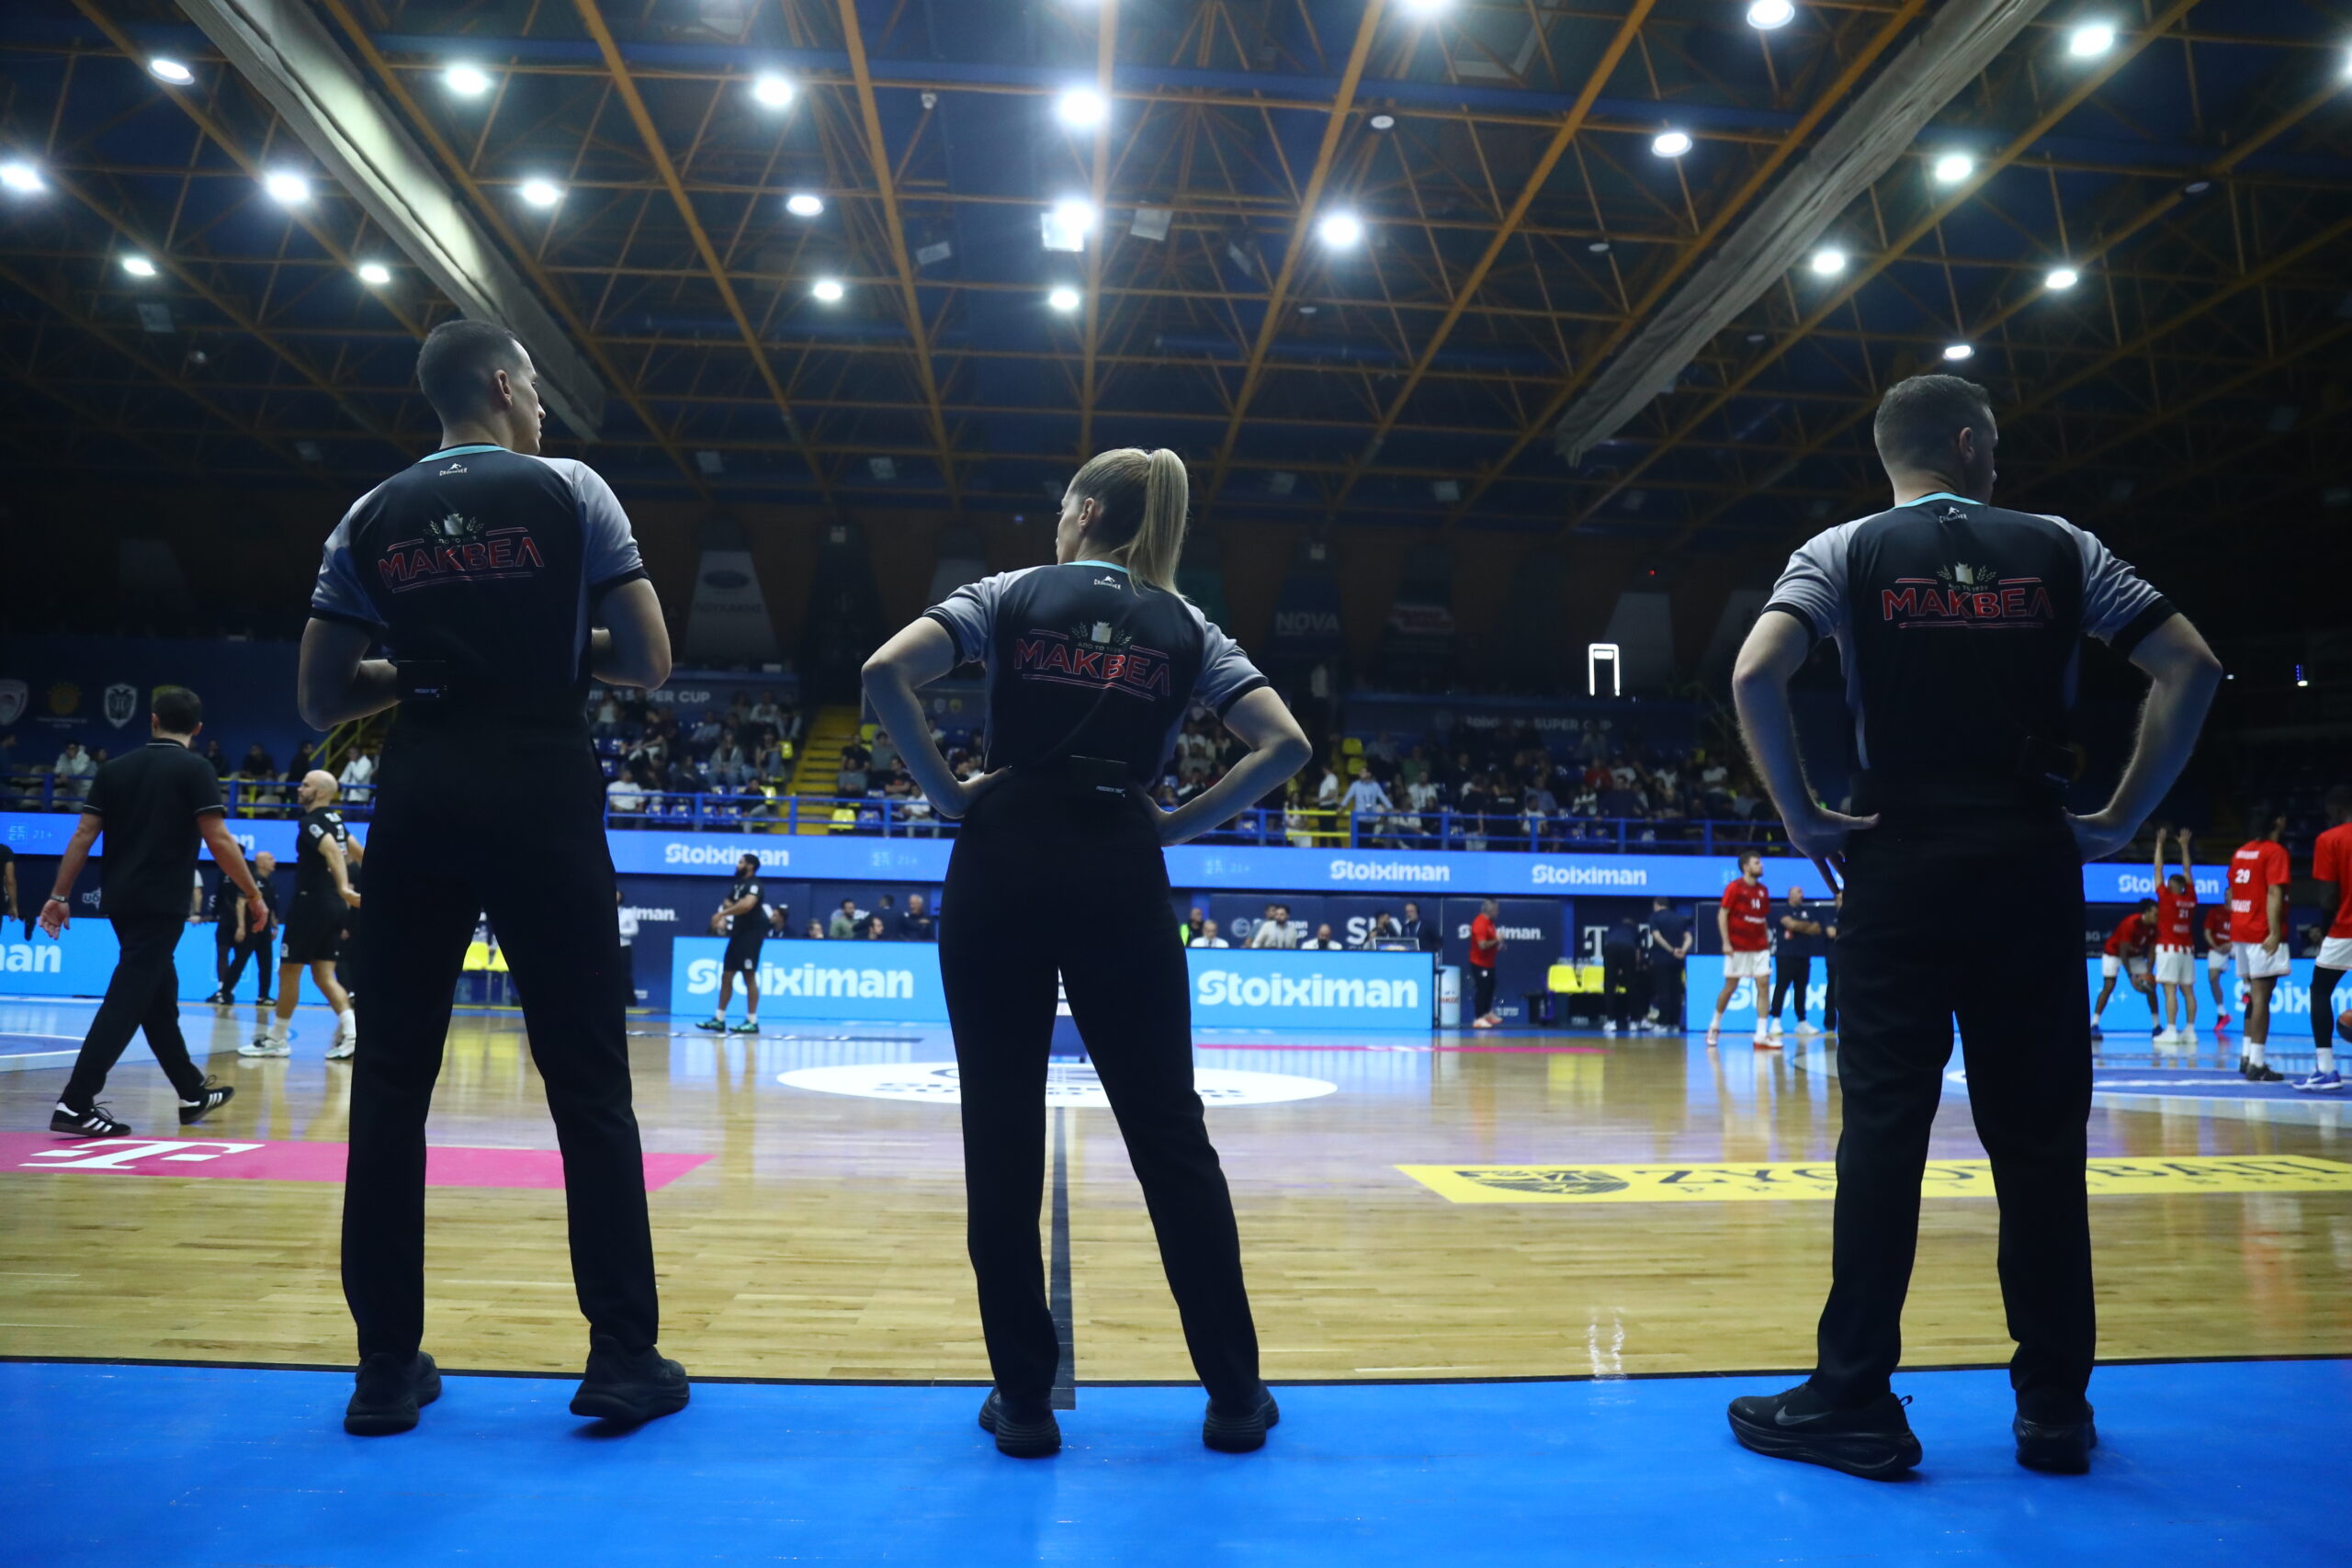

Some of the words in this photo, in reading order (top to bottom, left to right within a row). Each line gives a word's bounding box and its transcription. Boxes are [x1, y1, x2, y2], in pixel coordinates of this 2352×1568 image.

[1882, 586, 2055, 621] ΜΑΚΒΕΛ
[1275, 611, 1341, 632] NOVA
[1014, 638, 1170, 697] ΜΑΚΒΕΛ
[678, 691, 711, 704] CUP
[1329, 859, 1450, 882] Stoiximan
[1531, 863, 1647, 886] Stoiximan
[2234, 868, 2251, 885] 29
[1197, 970, 1419, 1009] Stoiximan
